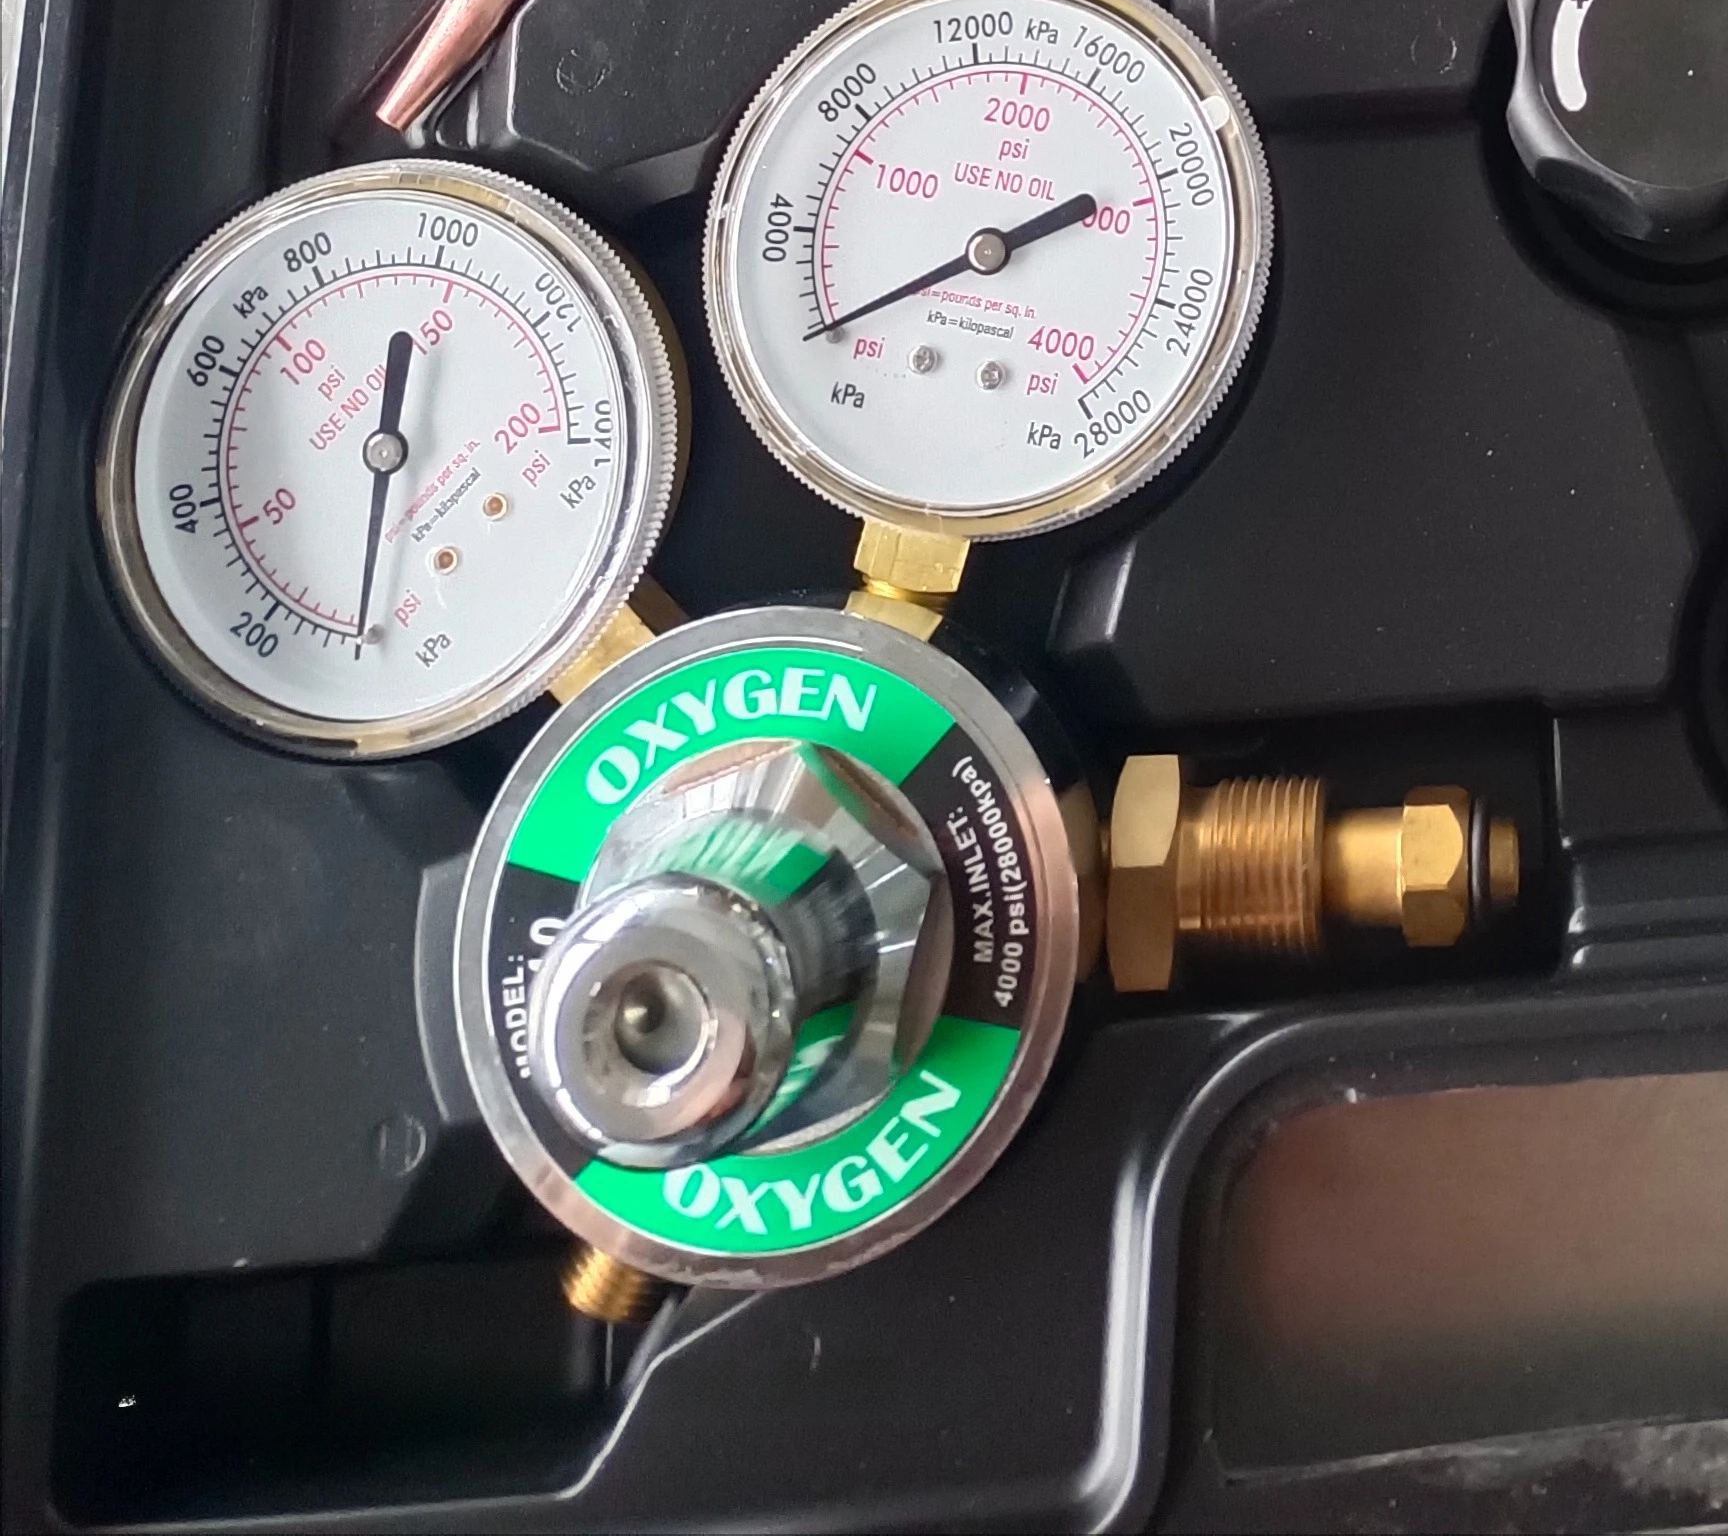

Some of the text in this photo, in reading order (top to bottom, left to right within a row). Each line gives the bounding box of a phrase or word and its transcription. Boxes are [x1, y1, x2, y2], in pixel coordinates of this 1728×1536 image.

[933, 11, 1014, 44] 12000
[1025, 18, 1059, 45] kPa
[1072, 25, 1146, 84] 16000
[817, 62, 877, 122] 8000
[983, 97, 1051, 133] 2000
[998, 138, 1030, 161] psi
[1168, 122, 1215, 207] 20000
[876, 163, 939, 199] 1000
[954, 162, 1056, 202] USE NO OIL
[417, 212, 479, 248] 1000
[762, 193, 795, 263] 4000
[1081, 206, 1131, 235] 000
[283, 231, 332, 273] 800
[232, 285, 269, 320] kPa
[535, 271, 582, 333] 1200
[983, 297, 1004, 313] per
[1166, 268, 1214, 357] 24000
[411, 308, 454, 356] 150
[853, 336, 888, 361] psi
[1027, 325, 1095, 362] 4000
[186, 334, 225, 387] 600
[279, 338, 327, 385] 100
[317, 364, 346, 401] psi
[829, 380, 866, 410] kPa
[1026, 372, 1059, 396] psi
[308, 412, 347, 451] USE
[341, 388, 370, 419] NO
[494, 402, 541, 455] 200
[594, 399, 613, 468] 1400
[1026, 420, 1063, 451] kPa
[1073, 388, 1153, 460] 28000
[521, 449, 551, 488] psi
[169, 483, 198, 535] 400
[262, 488, 297, 526] 50
[560, 474, 597, 509] kPa
[394, 588, 422, 628] psi
[229, 611, 279, 658] 200
[415, 632, 453, 668] kPa
[584, 667, 877, 806] OXYGEN
[951, 755, 1029, 1008] 4000 psi(28000kpa)
[661, 1069, 962, 1234] OXYGEN
